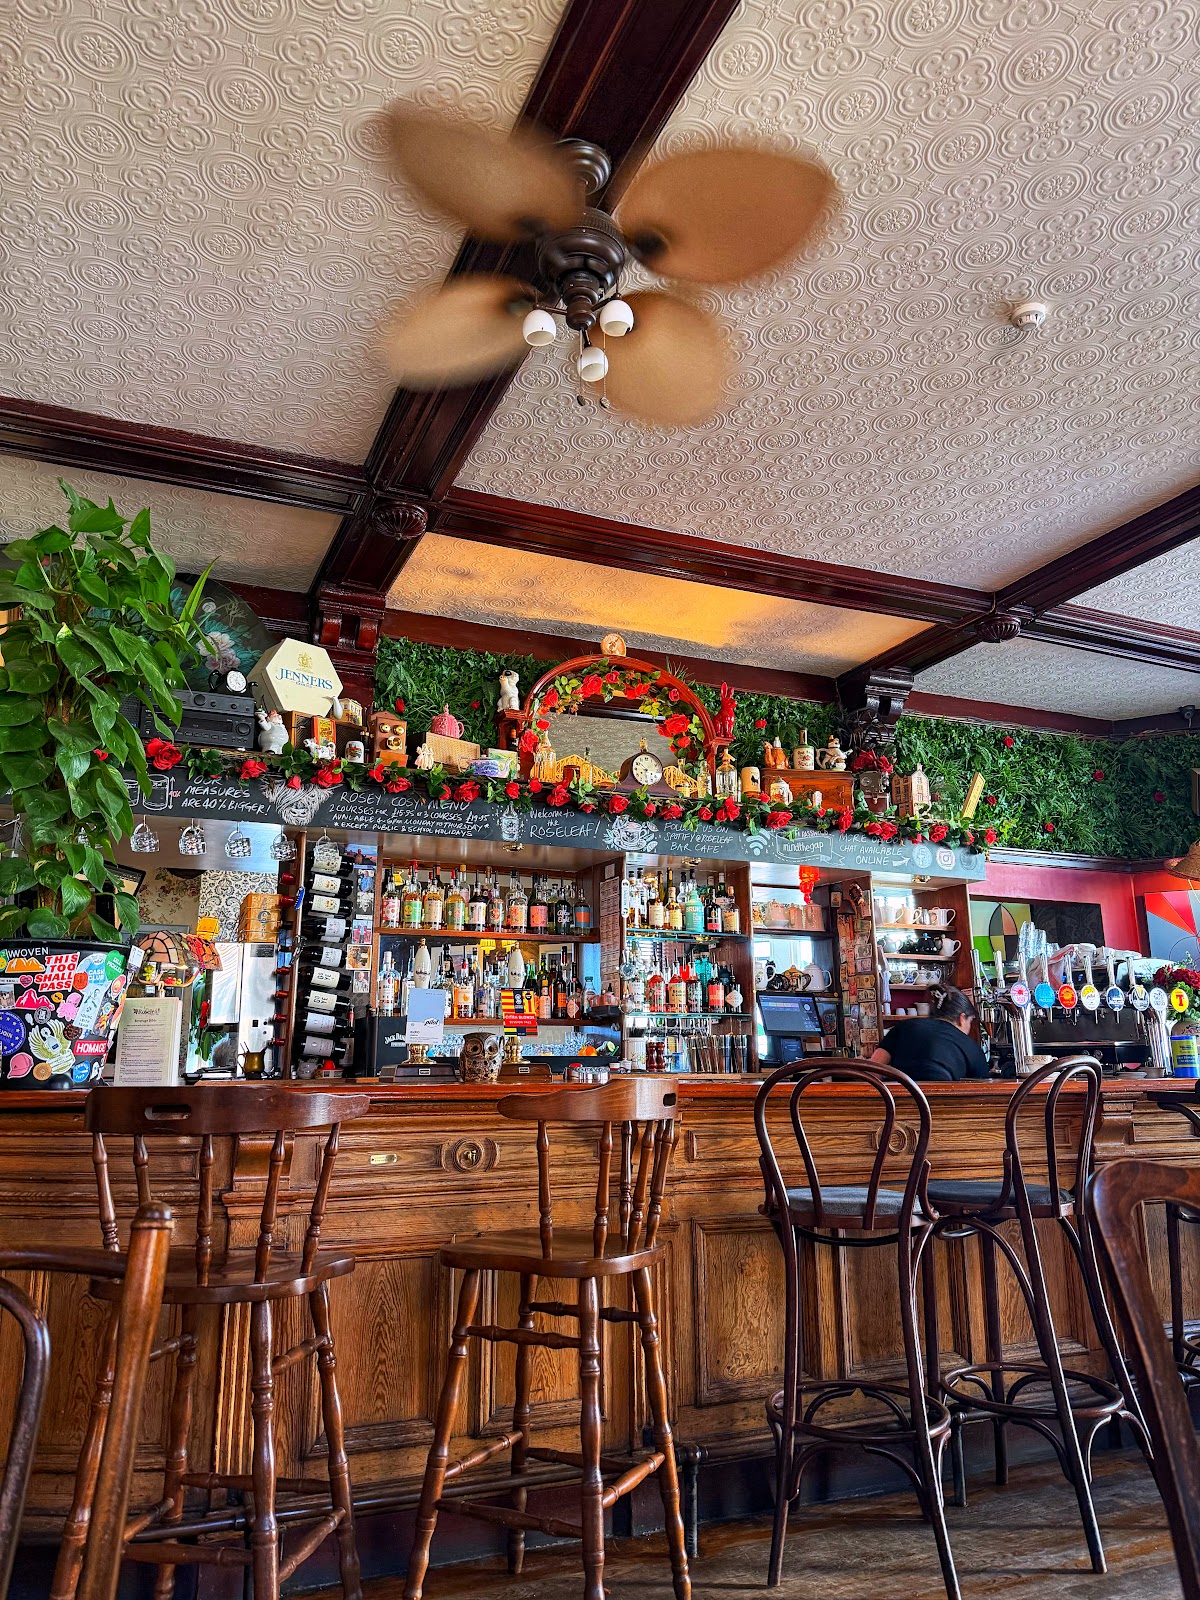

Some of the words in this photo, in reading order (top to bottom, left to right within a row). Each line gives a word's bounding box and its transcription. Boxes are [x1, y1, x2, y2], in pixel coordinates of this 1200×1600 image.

[276, 668, 333, 690] JENNERS
[184, 785, 251, 798] MEASURES
[340, 791, 382, 805] ROSEY
[391, 796, 420, 810] COSY
[181, 797, 202, 808] ARE
[202, 798, 227, 810] 40%
[227, 800, 271, 816] BIGGER!
[329, 803, 335, 812] 2
[336, 804, 374, 815] COURSES
[375, 808, 388, 816] FOR
[423, 810, 429, 818] 3
[430, 812, 462, 821] COURSES
[530, 807, 562, 819] Welcome
[563, 809, 575, 818] to
[332, 813, 375, 823] AVAILABLE
[404, 819, 436, 828] MONDAY
[372, 823, 399, 831] PUBLIC
[434, 828, 473, 837] HOLIDAYS
[530, 820, 601, 839] ROSELEAF!
[839, 833, 867, 842] MORE
[670, 842, 692, 851] BAR
[783, 841, 824, 852] mindthegap
[840, 845, 859, 853] CHAT
[860, 846, 902, 856] AVAILABLE
[856, 855, 889, 866] ONLINE
[8, 947, 49, 958] WOVEN
[45, 954, 79, 965] THIS
[50, 963, 77, 973] TOO
[35, 972, 73, 983] SHALL
[40, 980, 72, 991] PASS
[1175, 994, 1185, 1007] T
